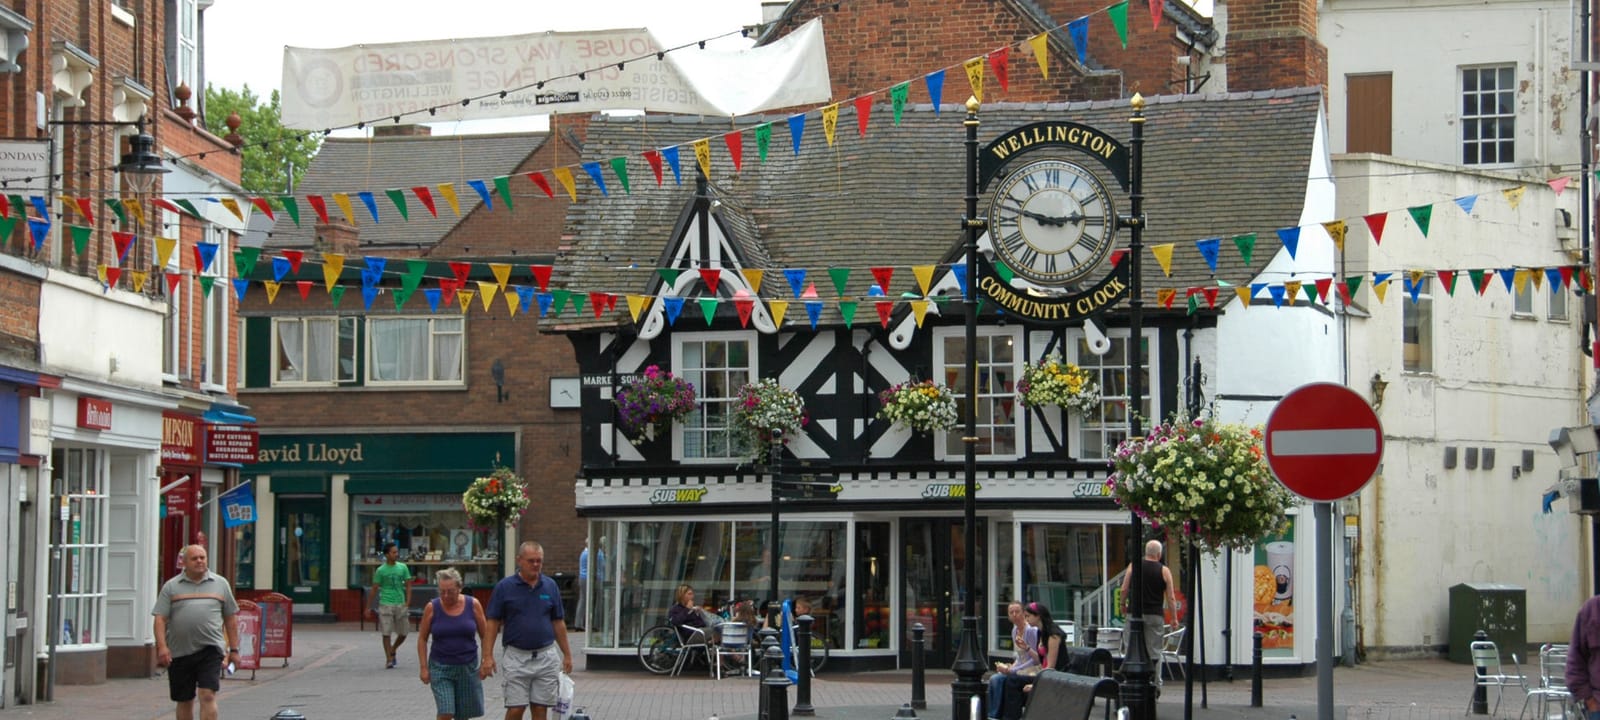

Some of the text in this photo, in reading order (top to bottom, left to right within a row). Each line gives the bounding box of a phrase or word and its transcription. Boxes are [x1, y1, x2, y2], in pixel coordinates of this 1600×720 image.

[992, 126, 1116, 160] WELLINGTON
[980, 276, 1126, 319] COMMUNITY CLOCK
[584, 376, 613, 385] MARKE
[162, 416, 194, 447] IMPSON
[258, 443, 363, 465] avid Lloyd
[650, 488, 707, 503] SUBWAY
[1074, 482, 1112, 497] SUBW
